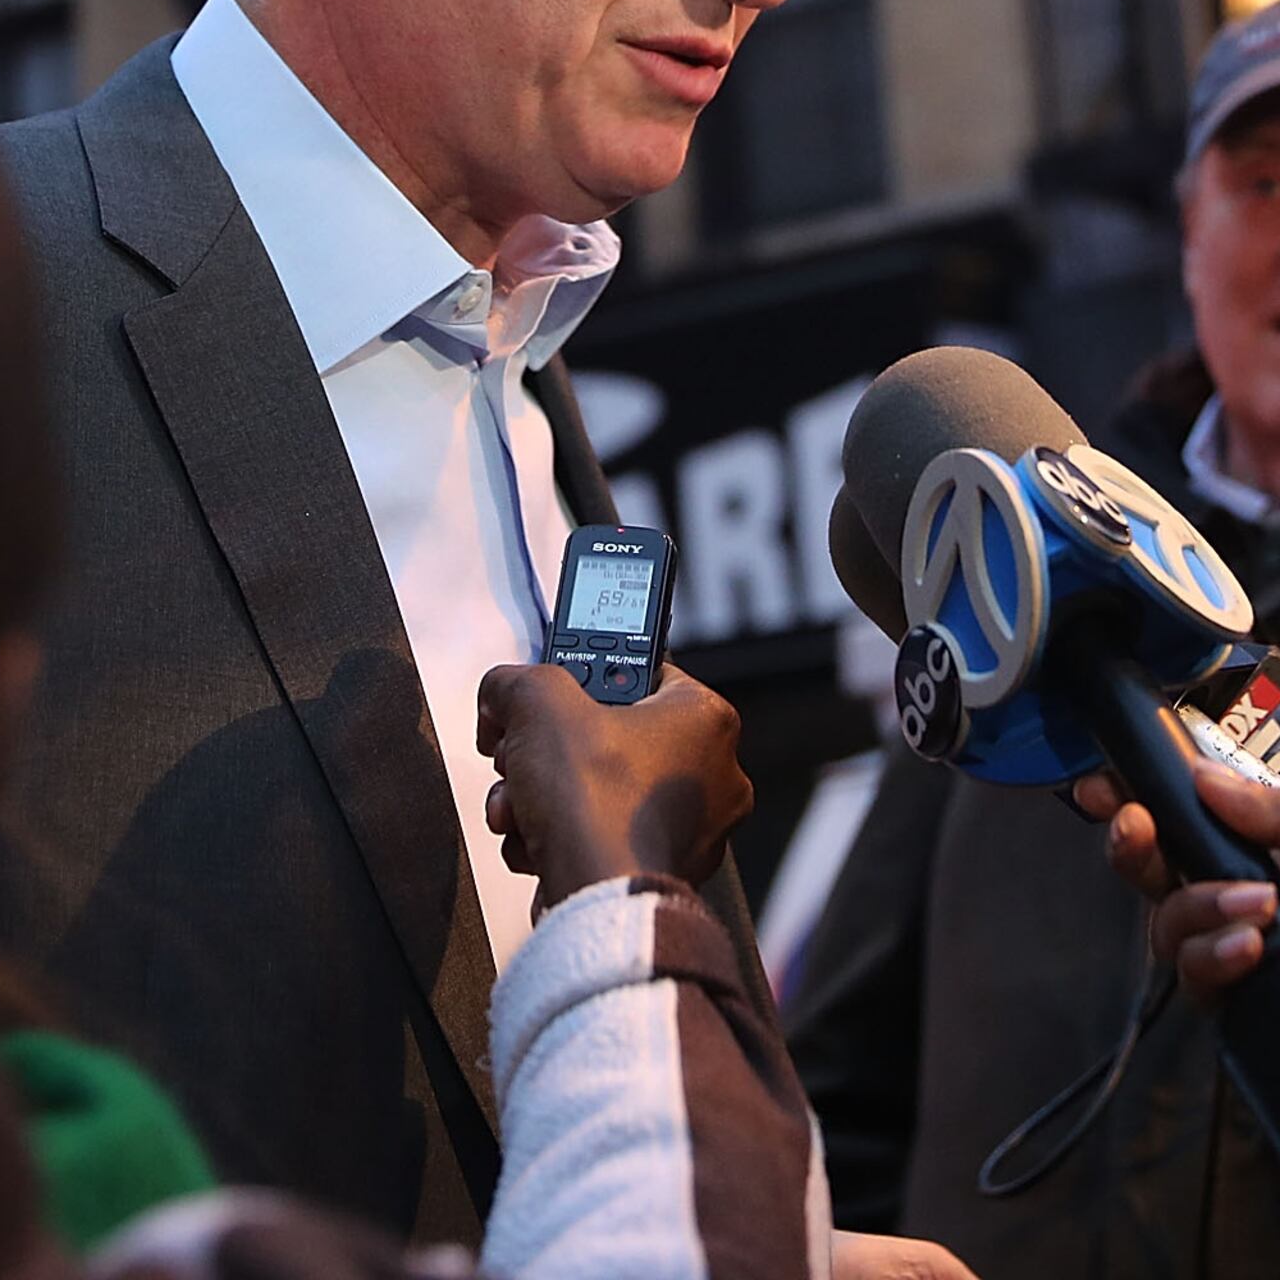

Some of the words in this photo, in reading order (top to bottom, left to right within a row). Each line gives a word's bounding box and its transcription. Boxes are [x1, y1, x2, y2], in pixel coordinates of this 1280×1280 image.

[1036, 459, 1129, 528] abc
[592, 542, 644, 554] SONY
[556, 651, 597, 662] PLAY/STOP
[605, 654, 648, 666] REC/PAUSE
[900, 634, 954, 745] abc
[1218, 692, 1269, 744] OX
